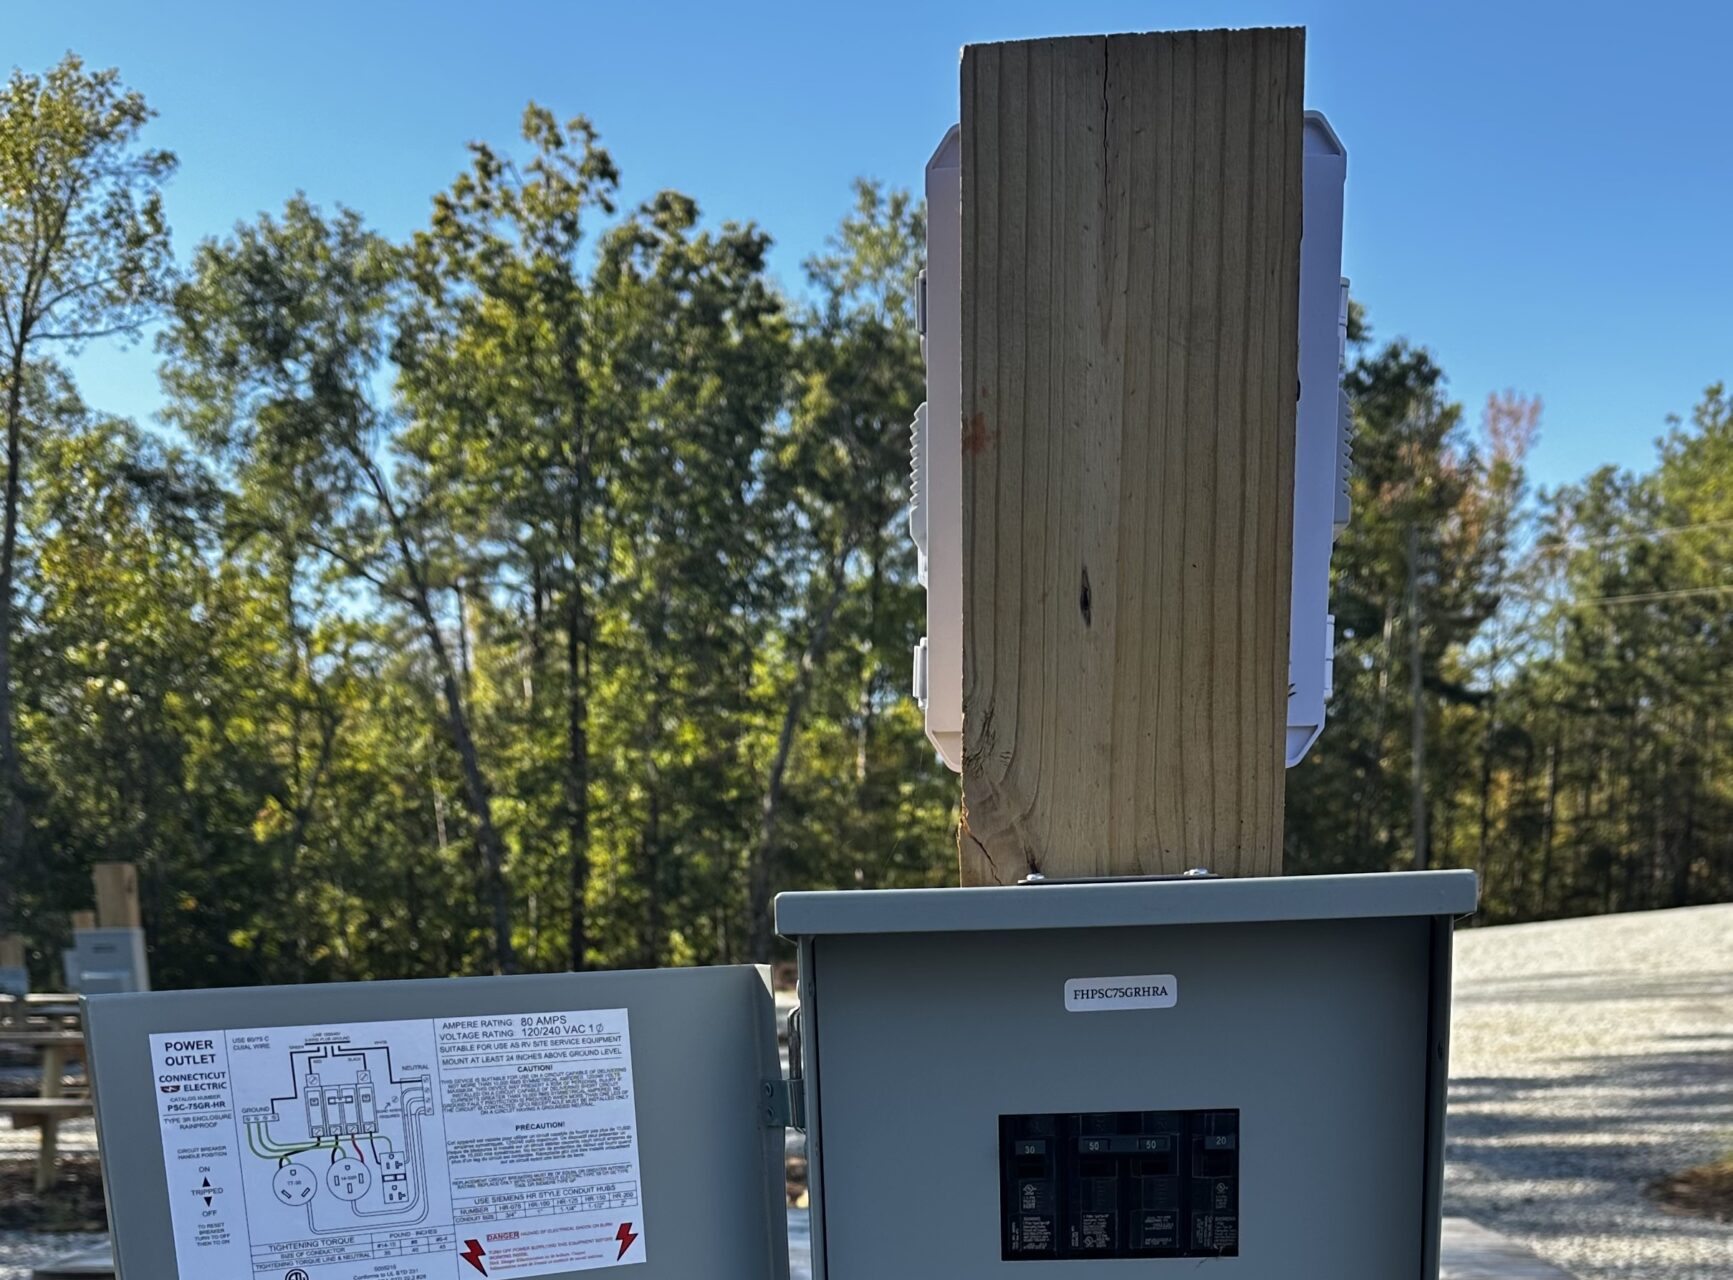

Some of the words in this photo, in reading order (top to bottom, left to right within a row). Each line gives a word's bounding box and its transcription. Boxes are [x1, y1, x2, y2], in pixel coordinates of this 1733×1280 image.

[1073, 985, 1168, 1000] FHPSC75GRHRA
[442, 1020, 479, 1030] AMPERE
[480, 1018, 512, 1028] RATING
[520, 1017, 533, 1025] 80
[535, 1015, 567, 1024] AMPS
[438, 1030, 479, 1041] VOLTAGE
[481, 1028, 513, 1039] RATING
[522, 1025, 560, 1036] 120/240
[562, 1024, 585, 1034] VAC
[164, 1039, 213, 1051] POWER
[439, 1044, 474, 1053] SUITABLE
[550, 1037, 579, 1046] SERVICE
[581, 1035, 621, 1044] EQUIPMENT
[164, 1053, 216, 1066] OUTLET
[442, 1057, 469, 1065] MOUNT
[481, 1055, 504, 1063] LEAST
[515, 1052, 543, 1060] INCHES
[568, 1048, 599, 1057] GROUND
[517, 1064, 552, 1072] CAUTION!
[158, 1071, 226, 1082] CONNECTICUT
[183, 1081, 227, 1091] ELECTRIC
[192, 1113, 231, 1121] ENCLOSURE
[1024, 1145, 1036, 1154] 30
[1088, 1141, 1100, 1150] 50
[1145, 1140, 1157, 1149] 50
[1216, 1136, 1227, 1145] 20
[190, 1187, 224, 1196] TRIPPED
[491, 1193, 524, 1203] SIEMENS
[538, 1189, 560, 1198] STYLE
[562, 1186, 594, 1195] CONDUIT
[596, 1184, 616, 1192] HUBS
[487, 1231, 519, 1241] DANGER
[268, 1240, 318, 1252] TIGHTENING
[321, 1236, 354, 1246] TORQUE
[255, 1260, 293, 1270] TIGHTENING
[342, 1252, 371, 1260] NEUTRAL
